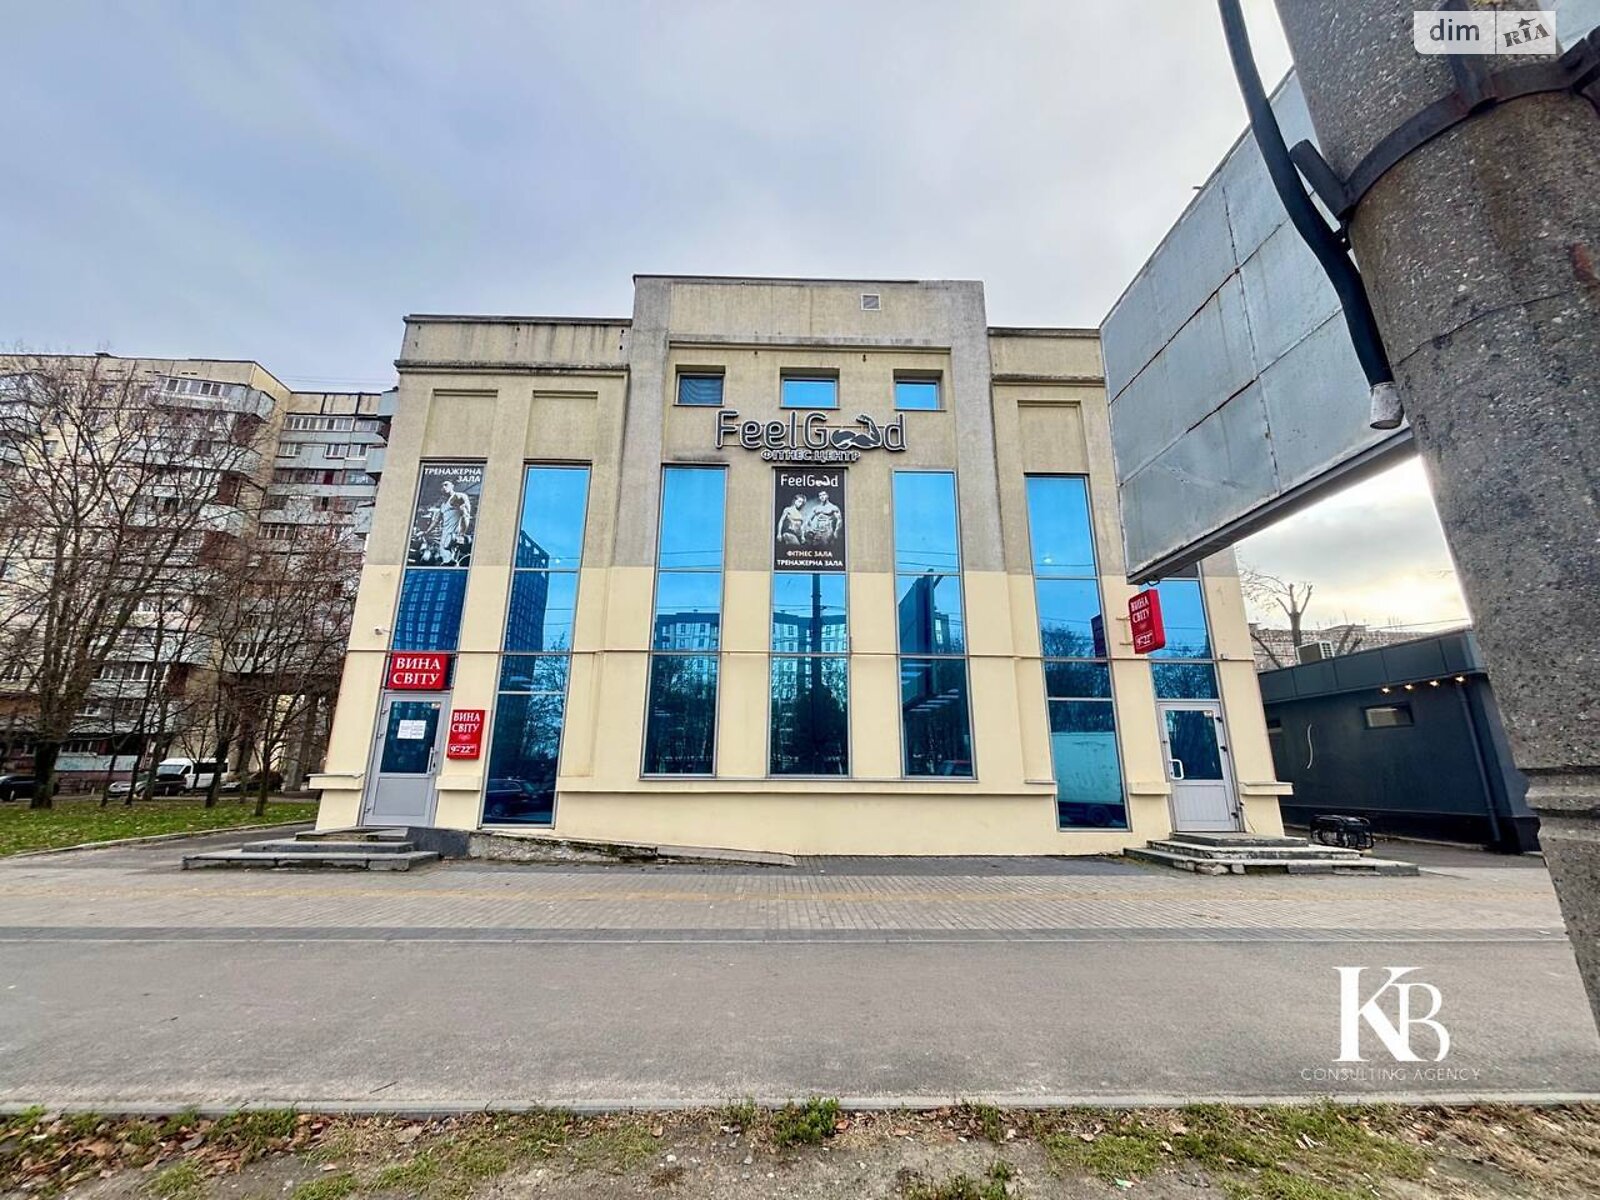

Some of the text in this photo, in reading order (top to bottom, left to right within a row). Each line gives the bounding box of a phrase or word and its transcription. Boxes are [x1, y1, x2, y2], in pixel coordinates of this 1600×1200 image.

[760, 449, 861, 463] ФІТНЕС ЦЕНТР
[424, 467, 482, 476] ТРЕНАЖЕРНА
[457, 475, 481, 483] ЗАЛА
[395, 657, 441, 670] ВИНА
[392, 672, 440, 685] СВІТУ
[453, 712, 481, 722] ВИНА
[451, 723, 480, 732] СВІТУ
